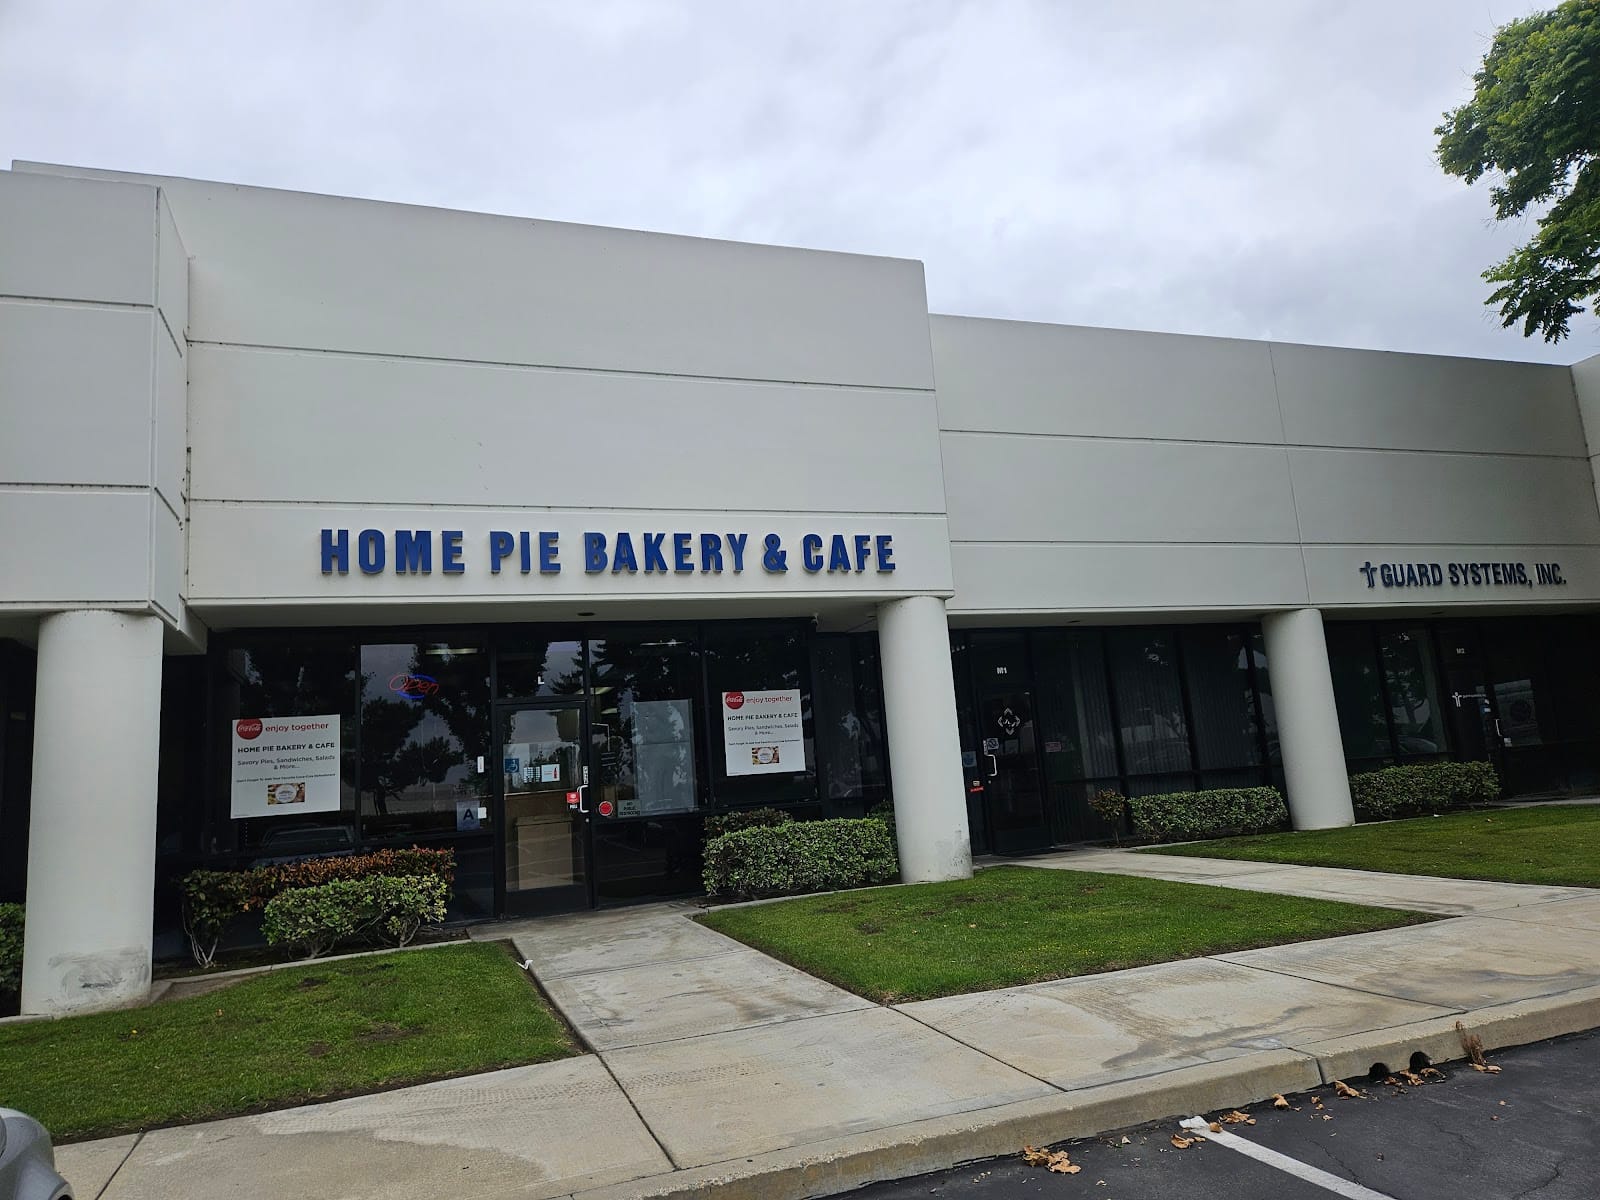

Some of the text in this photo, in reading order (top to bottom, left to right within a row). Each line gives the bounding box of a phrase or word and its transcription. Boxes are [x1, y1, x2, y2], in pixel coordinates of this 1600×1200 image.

[321, 529, 896, 574] HOME PIE BAKERY & CAFE
[1380, 562, 1567, 588] GUARD SYSTEMS, INC.
[746, 695, 793, 704] enjoy together
[265, 722, 329, 733] enjoy together
[276, 743, 306, 751] BAKERY
[463, 807, 474, 821] A
